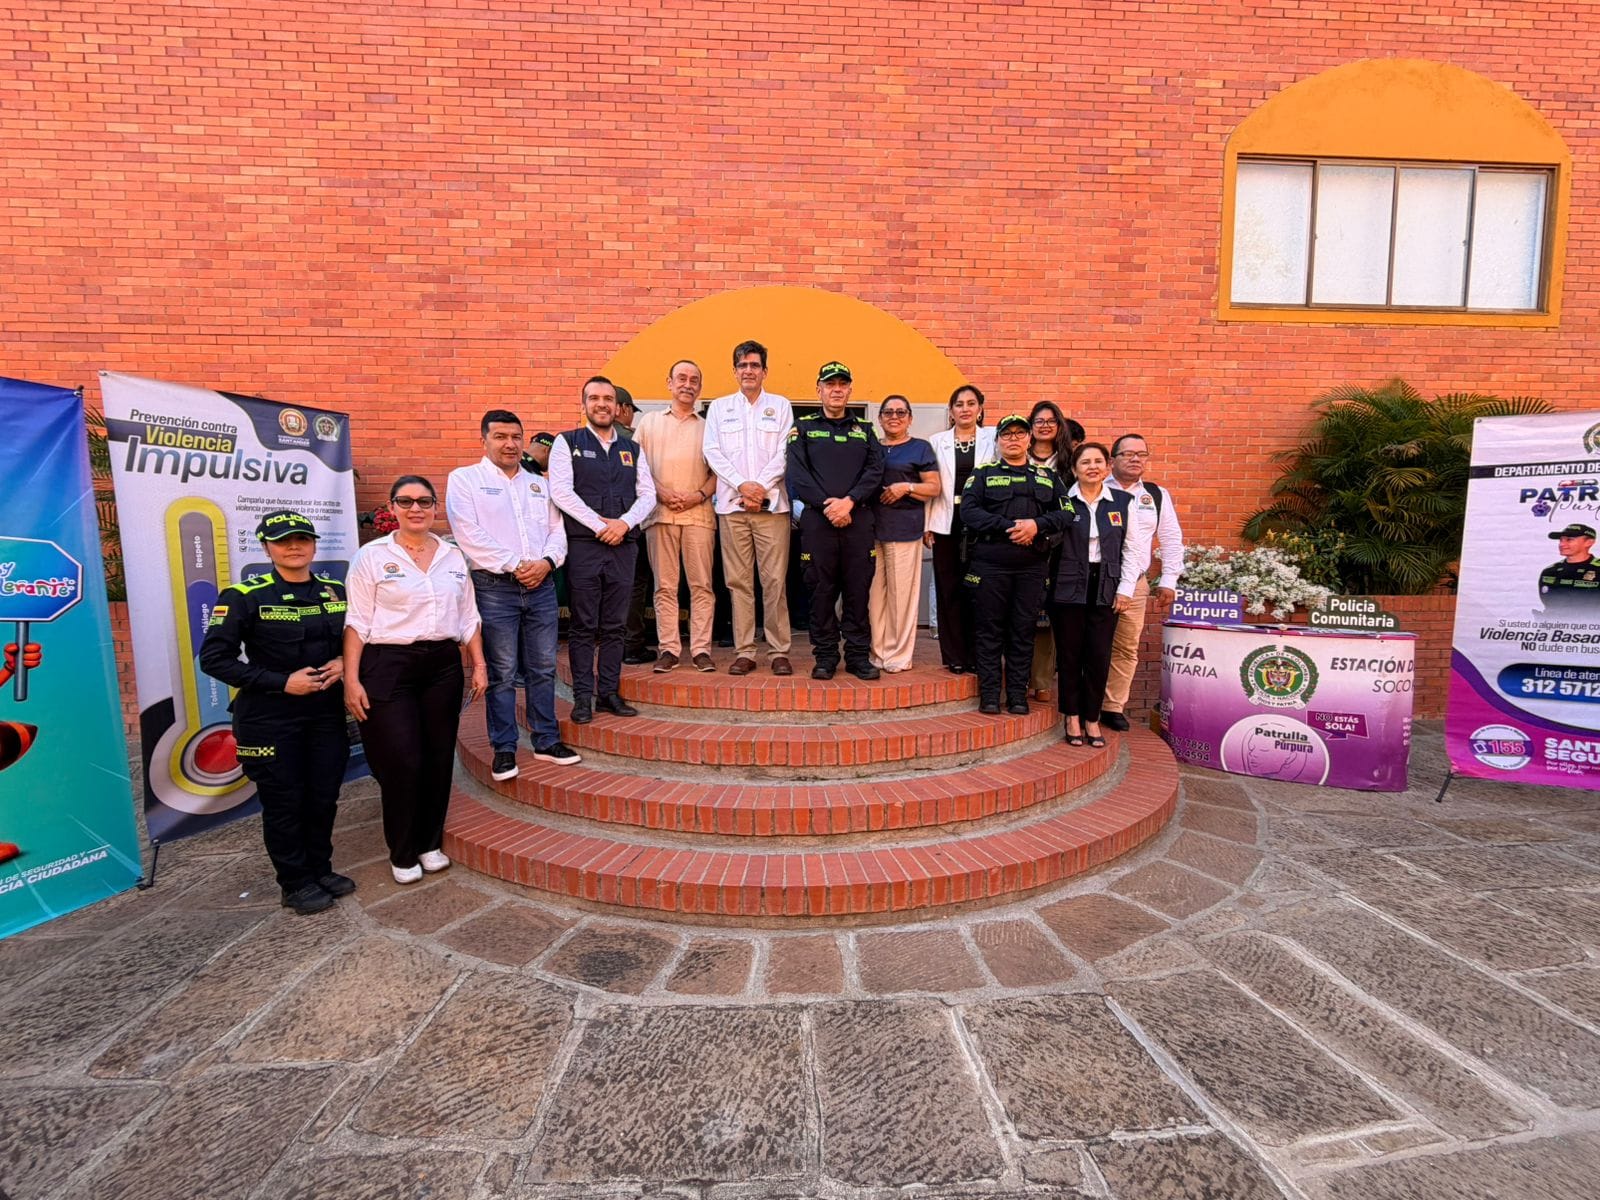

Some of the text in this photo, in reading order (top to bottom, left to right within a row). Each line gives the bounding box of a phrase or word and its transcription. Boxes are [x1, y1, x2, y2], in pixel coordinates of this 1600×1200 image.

[130, 409, 238, 434] Prevención contra
[145, 425, 233, 453] Violencia
[125, 436, 309, 486] Impulsiva
[1494, 463, 1585, 477] DEPARTAMENTO
[1519, 486, 1600, 503] PATR
[195, 535, 203, 568] Respeto
[1174, 589, 1238, 603] Patrulla
[1173, 603, 1238, 620] Púrpura
[1311, 611, 1394, 628] Comunitaria
[1499, 619, 1507, 628] Si
[1507, 620, 1531, 629] usted
[1539, 621, 1569, 631] alguien
[1570, 623, 1587, 632] que
[1480, 627, 1547, 642] Violencia
[1521, 642, 1536, 651] NO
[1538, 643, 1563, 653] dude
[1565, 645, 1579, 653] en
[1330, 656, 1406, 673] ESTACIÓN
[1563, 669, 1577, 680] de
[1521, 678, 1600, 697] 312 5712
[1315, 713, 1333, 721] NO
[1255, 727, 1308, 741] Patrulla
[1325, 722, 1355, 731] SOLA!
[1544, 737, 1600, 753] SANT
[1544, 749, 1600, 765] SEGU
[5, 873, 20, 884] DE
[21, 855, 78, 878] SEGURIDAD
[27, 850, 108, 884] CIUDADANA
